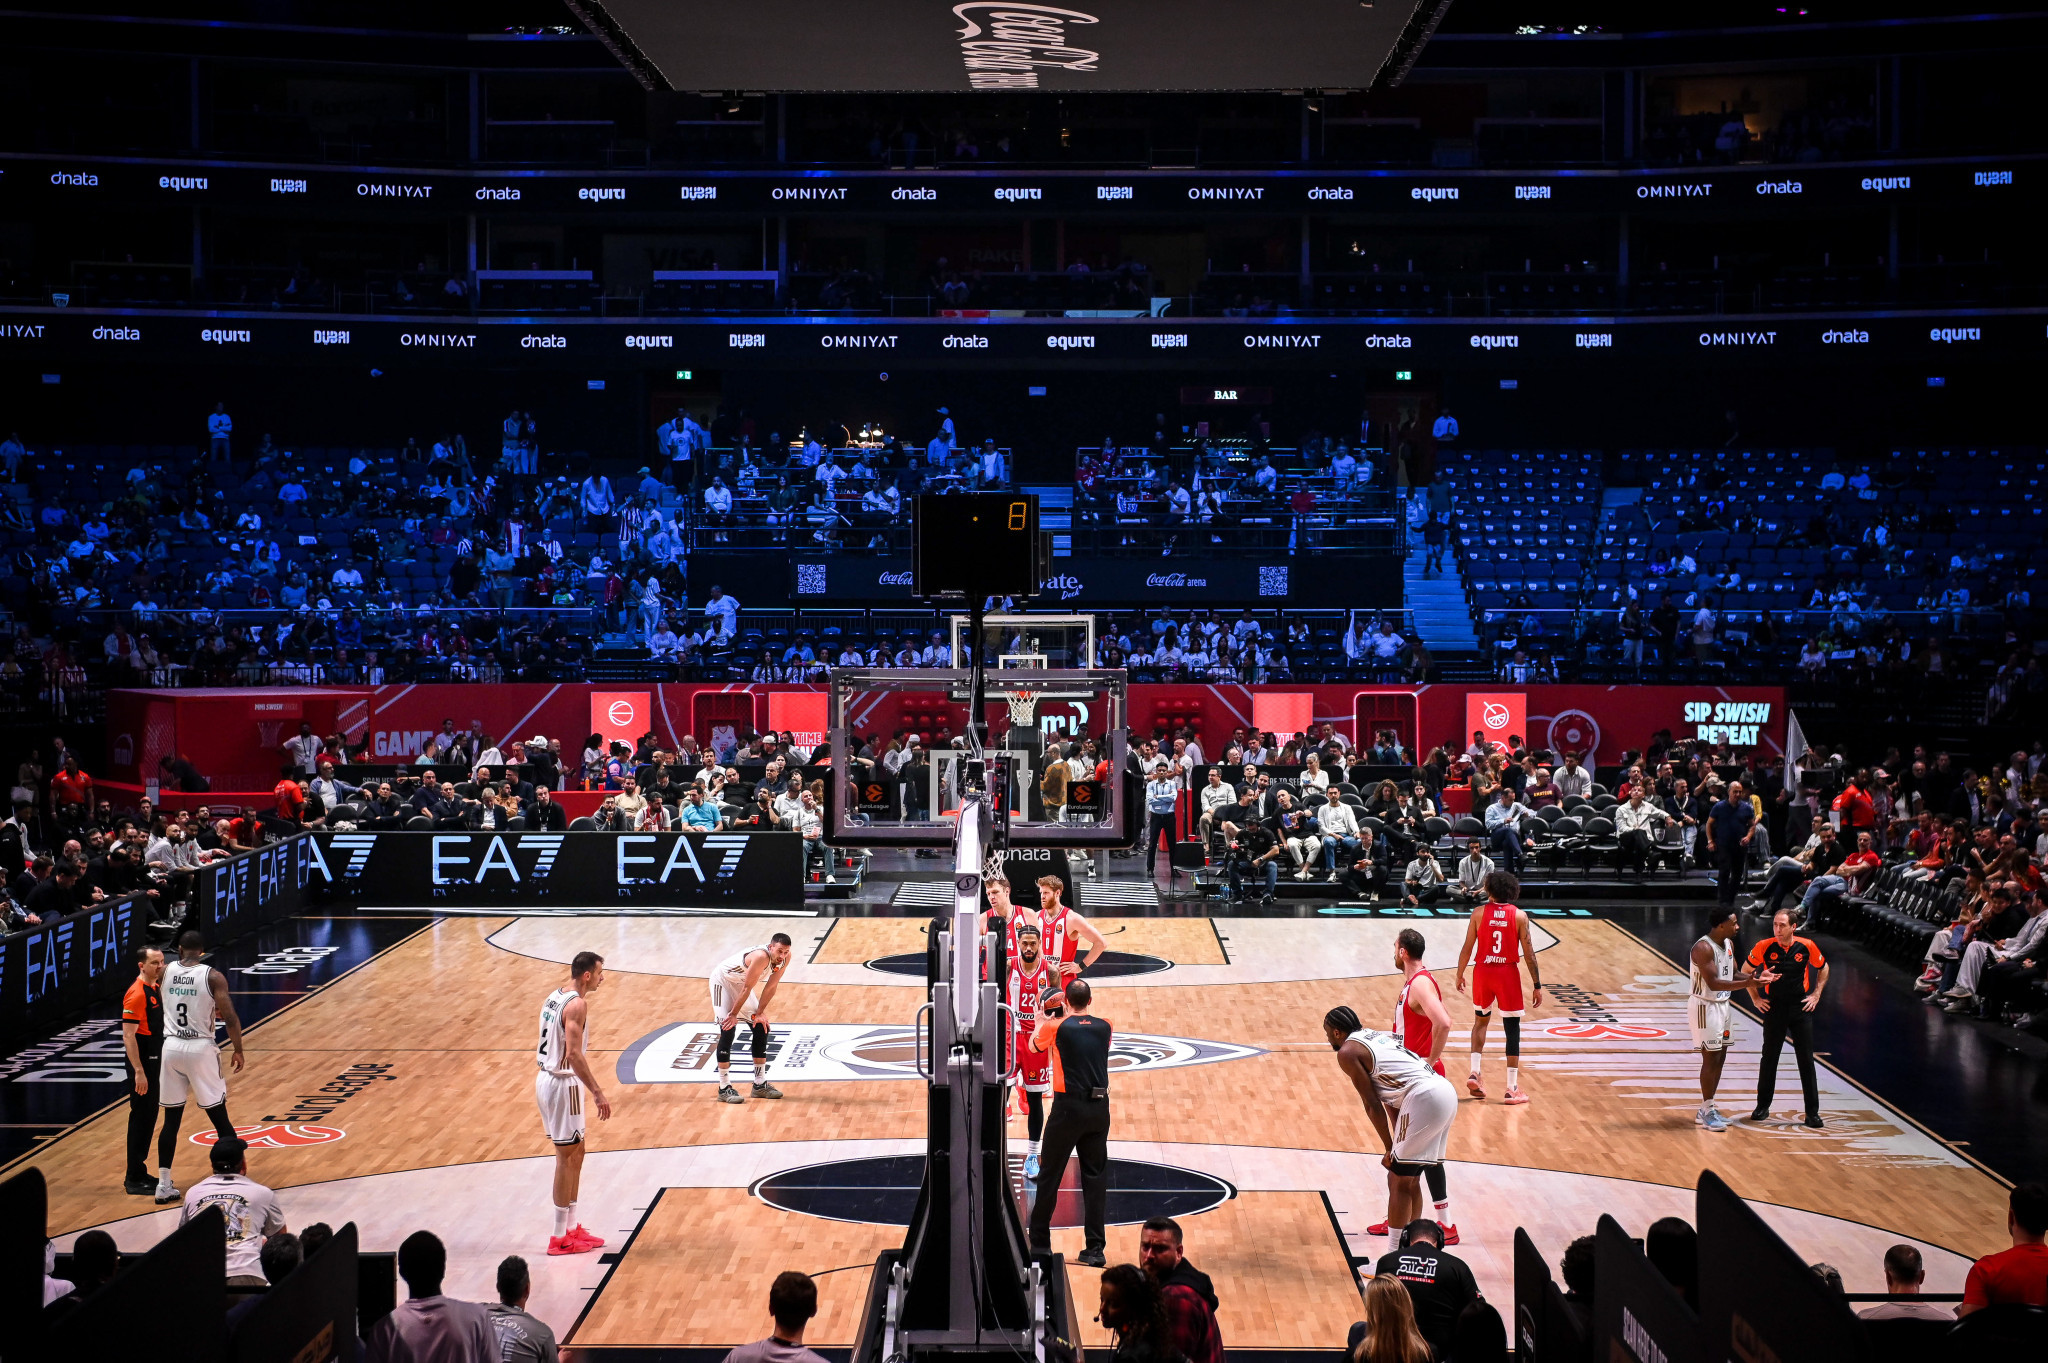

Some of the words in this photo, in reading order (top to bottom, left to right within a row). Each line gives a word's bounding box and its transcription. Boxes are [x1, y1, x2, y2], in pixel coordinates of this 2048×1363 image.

[952, 1, 1100, 72] Coca-Cola
[51, 171, 98, 187] dnata
[159, 177, 208, 192] equiti
[1862, 177, 1910, 192] equiti
[1975, 171, 2012, 186] DUBAI
[271, 179, 306, 194] DUBAI
[357, 184, 432, 197] OMNIYAT
[772, 188, 847, 199] OMNIYAT
[1188, 188, 1264, 199] OMNIYAT
[1515, 186, 1551, 200] DUBAI
[1637, 184, 1712, 198] OMNIYAT
[1756, 180, 1802, 194] dnata
[476, 187, 520, 201] dnata
[579, 188, 625, 202] equiti
[681, 187, 716, 201] DUBAI
[892, 187, 936, 201] dnata
[994, 188, 1041, 202] equiti
[1097, 187, 1133, 201] DUBAI
[1308, 187, 1353, 201] dnata
[1411, 188, 1459, 202] equiti
[0, 325, 45, 338] NIYAT
[93, 326, 140, 341] dnata
[202, 329, 250, 344] equiti
[314, 330, 350, 345] DUBAI
[1822, 329, 1869, 344] dnata
[1930, 327, 1980, 343] equiti
[401, 334, 476, 347] OMNIYAT
[521, 334, 566, 348] dnata
[625, 335, 673, 350] equiti
[730, 334, 765, 348] DUBAI
[822, 335, 898, 348] OMNIYAT
[943, 334, 988, 348] dnata
[1047, 335, 1095, 350] equiti
[1152, 334, 1187, 348] DUBAI
[1244, 335, 1321, 348] OMNIYAT
[1366, 334, 1411, 348] dnata
[1470, 335, 1519, 350] equiti
[1576, 334, 1612, 348] DUBAI
[1700, 332, 1776, 346] OMNIYAT
[1213, 390, 1238, 400] BAR
[1007, 501, 1027, 531] 8
[1146, 572, 1187, 587] Coca-Cola
[1187, 577, 1206, 587] arena
[1061, 589, 1080, 601] Deck
[1684, 701, 1712, 723] SIP
[1713, 701, 1771, 724] SWISH
[859, 803, 890, 811] EuroLeague
[432, 834, 565, 885] EA7
[617, 834, 751, 885] EA7
[214, 857, 250, 924] EA7
[89, 900, 133, 978] EA7
[1492, 930, 1502, 954] 3
[26, 920, 74, 1004] EA7
[173, 975, 195, 986] BACON
[169, 987, 198, 997] equiti
[1021, 993, 1036, 1007] 22
[176, 1003, 188, 1027] 3
[261, 1063, 398, 1122] EuroLeague
